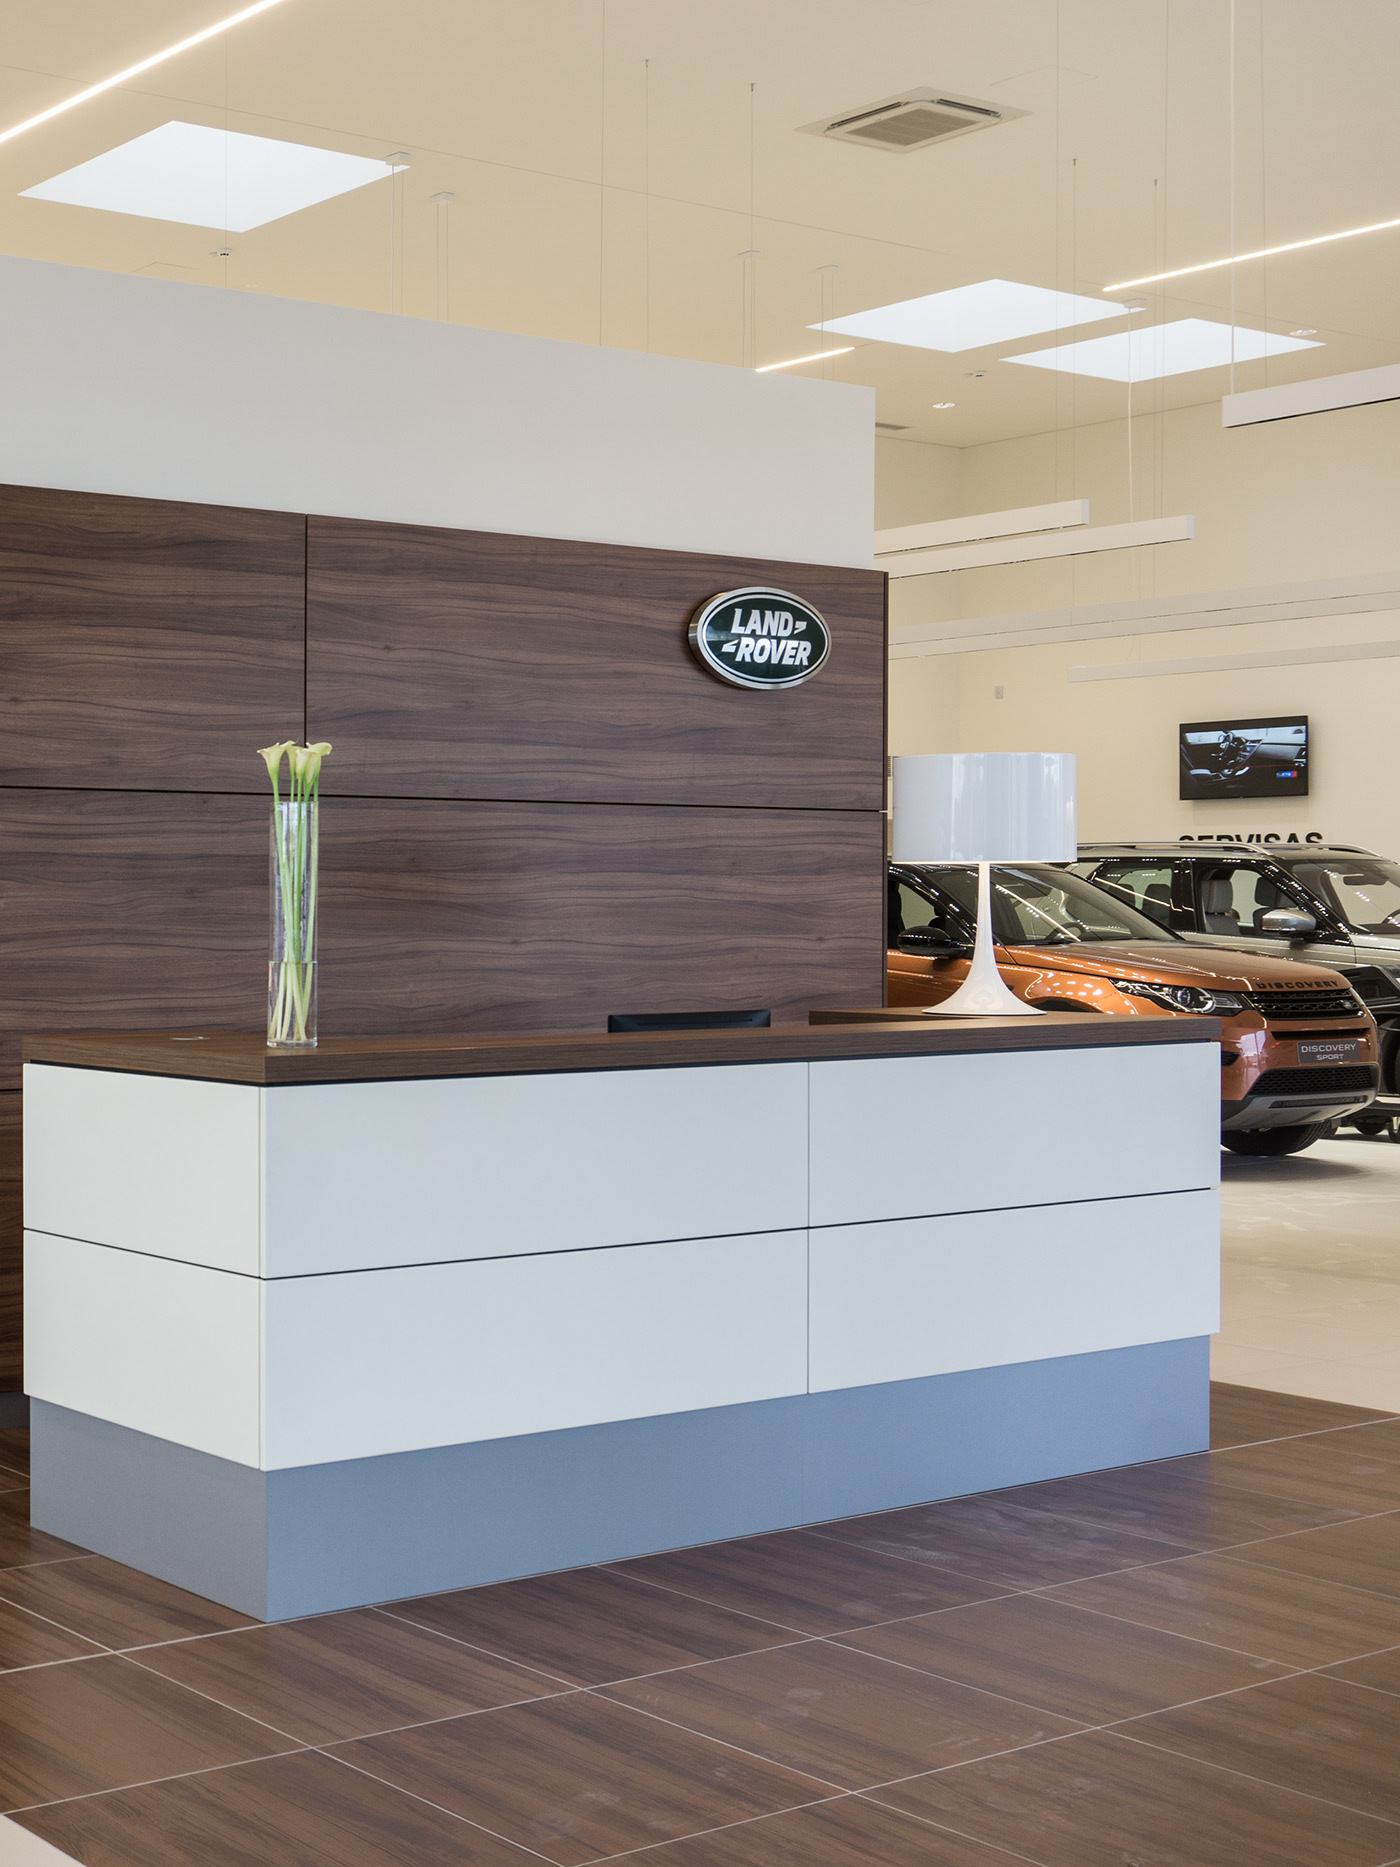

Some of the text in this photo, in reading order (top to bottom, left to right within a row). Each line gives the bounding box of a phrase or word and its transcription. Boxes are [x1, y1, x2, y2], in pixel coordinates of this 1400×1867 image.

[730, 607, 794, 637] LAND
[734, 636, 812, 666] ROVER
[1255, 980, 1339, 990] DISCOVERY
[1301, 1043, 1357, 1054] DISCOVERY
[1316, 1053, 1345, 1061] SPORT
